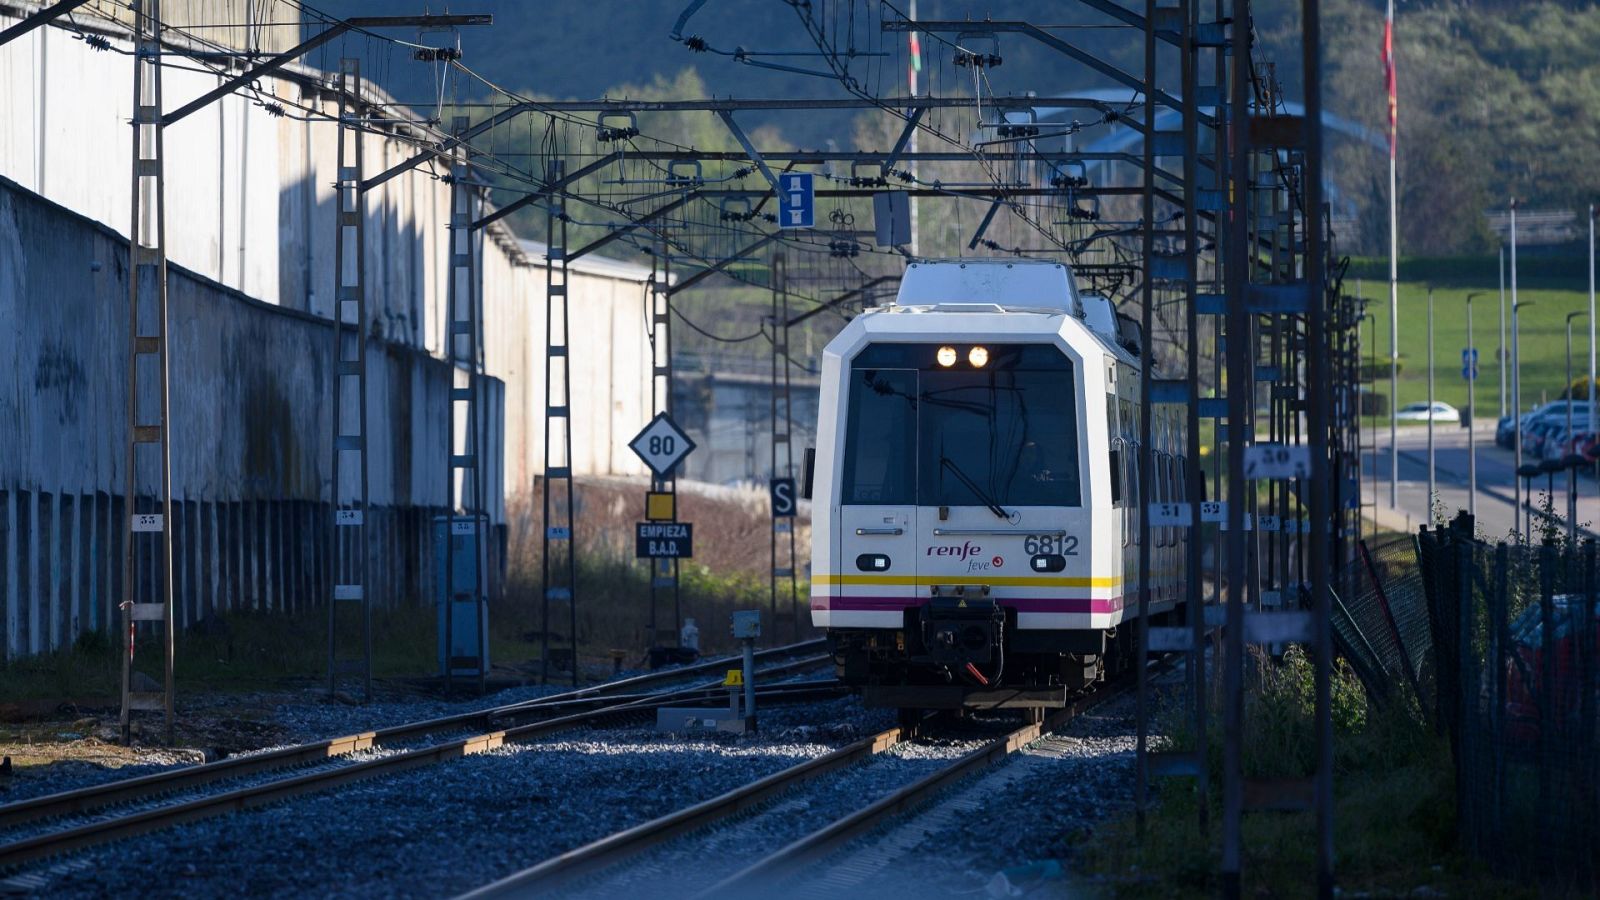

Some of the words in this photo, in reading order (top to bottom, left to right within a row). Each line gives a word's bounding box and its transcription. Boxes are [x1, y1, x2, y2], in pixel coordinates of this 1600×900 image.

[650, 435, 675, 456] 80
[775, 483, 792, 513] S
[1161, 505, 1179, 517] 31
[1203, 504, 1220, 514] 32
[640, 525, 688, 538] EMPIEZA
[649, 541, 679, 555] B.A.D.
[926, 541, 982, 562] renfe
[1024, 534, 1079, 556] 6812
[967, 558, 990, 573] feve
